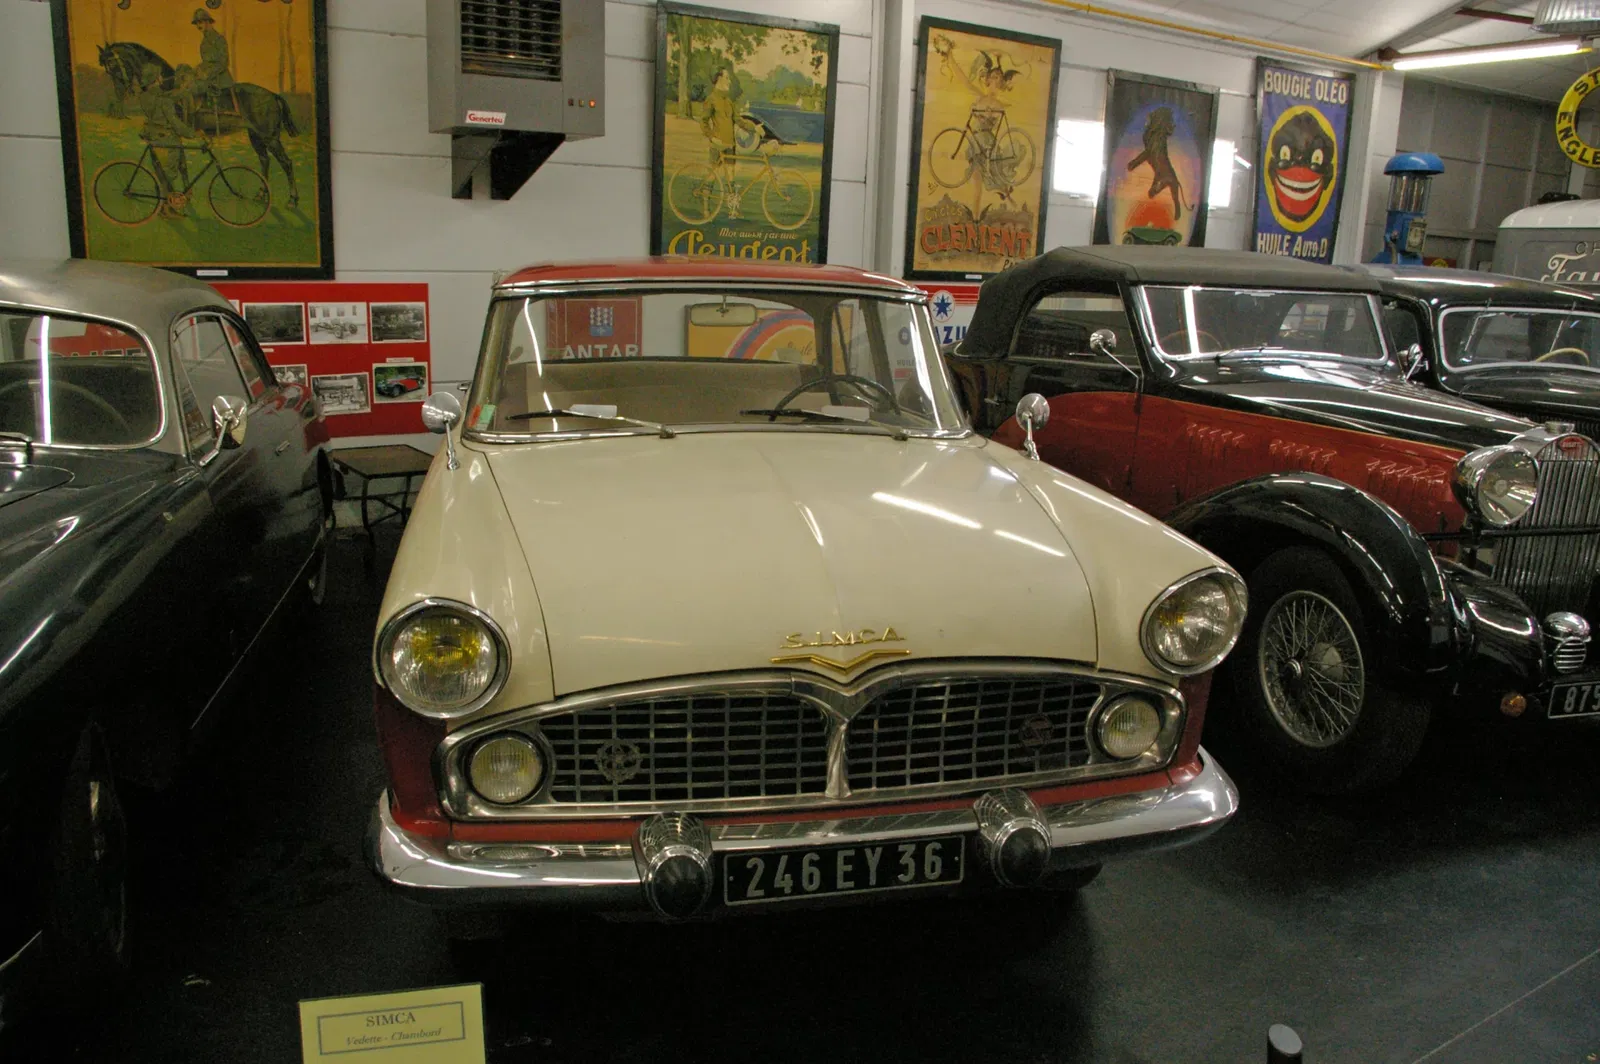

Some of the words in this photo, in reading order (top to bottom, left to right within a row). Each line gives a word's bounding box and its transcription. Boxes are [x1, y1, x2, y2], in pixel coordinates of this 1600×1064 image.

[1264, 70, 1312, 100] BOUGIE
[1257, 232, 1292, 256] HUILE
[561, 343, 639, 360] ANTAR
[780, 627, 907, 649] SIMCA
[746, 852, 821, 898] 246
[836, 847, 883, 890] EY
[897, 841, 943, 883] 36
[366, 1011, 417, 1028] SIMCA
[346, 1034, 382, 1046] Vedette
[391, 1027, 442, 1042] Chambord
